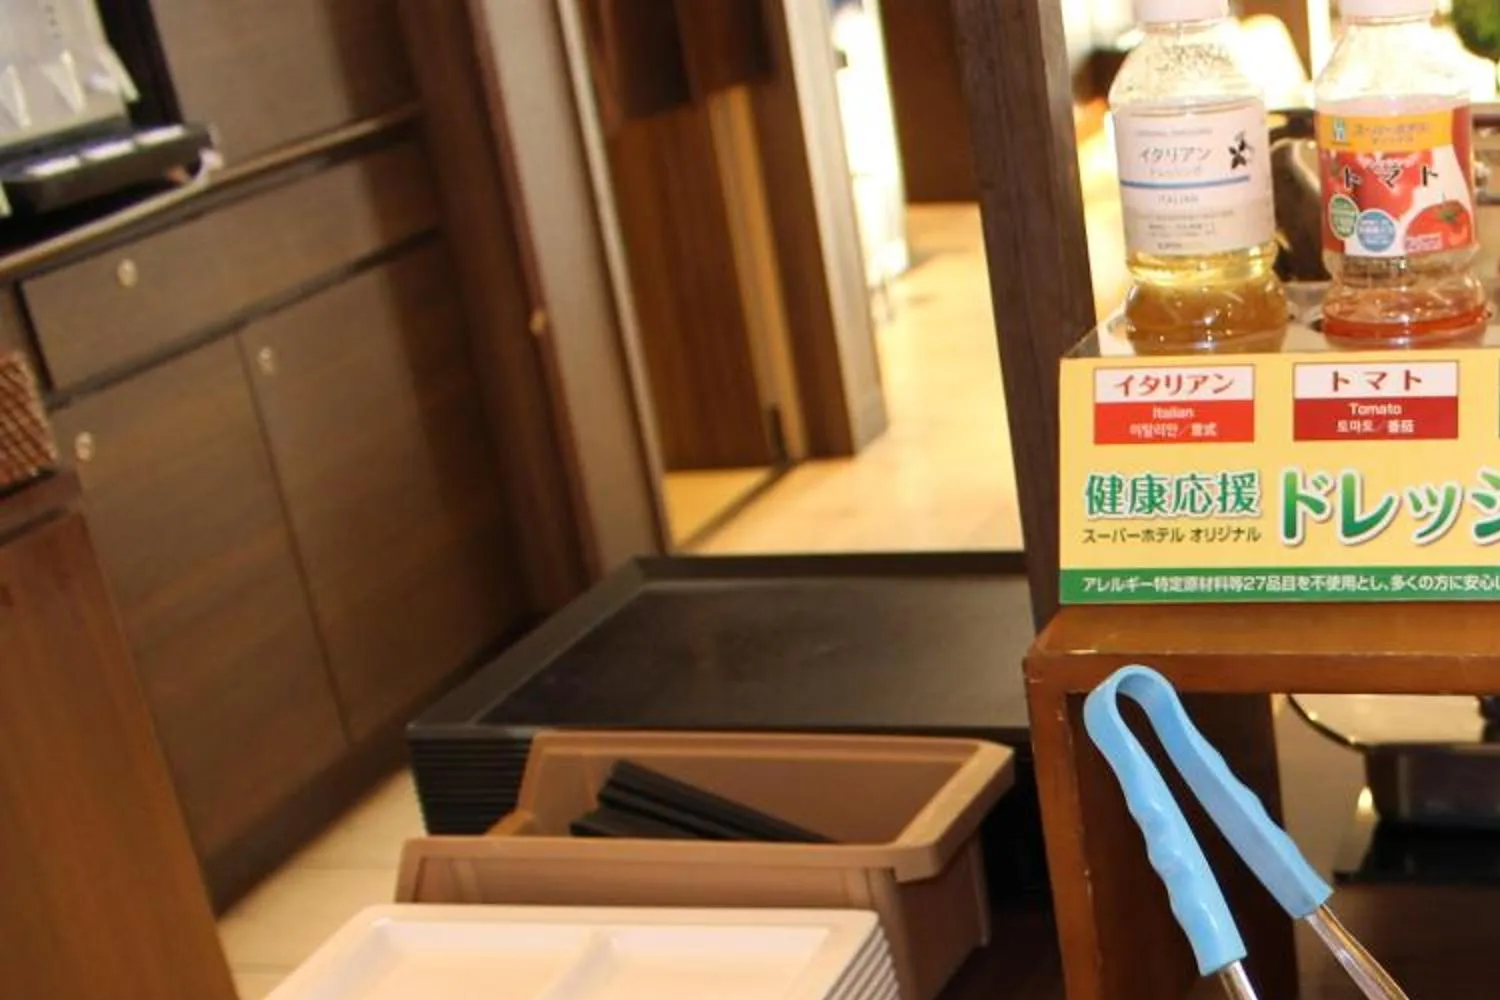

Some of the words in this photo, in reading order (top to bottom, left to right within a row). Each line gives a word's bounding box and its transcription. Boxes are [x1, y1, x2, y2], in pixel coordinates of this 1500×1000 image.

[1139, 146, 1213, 164] イタリアン
[1342, 163, 1440, 191] トマト
[1115, 374, 1236, 398] イタリアン
[1332, 369, 1422, 393] トマト
[1152, 406, 1196, 419] Italian
[1349, 403, 1402, 416] Tomato
[1084, 472, 1260, 517] 健康応援
[1082, 527, 1185, 544] スーパーホテル
[1190, 526, 1262, 544] オリジナル
